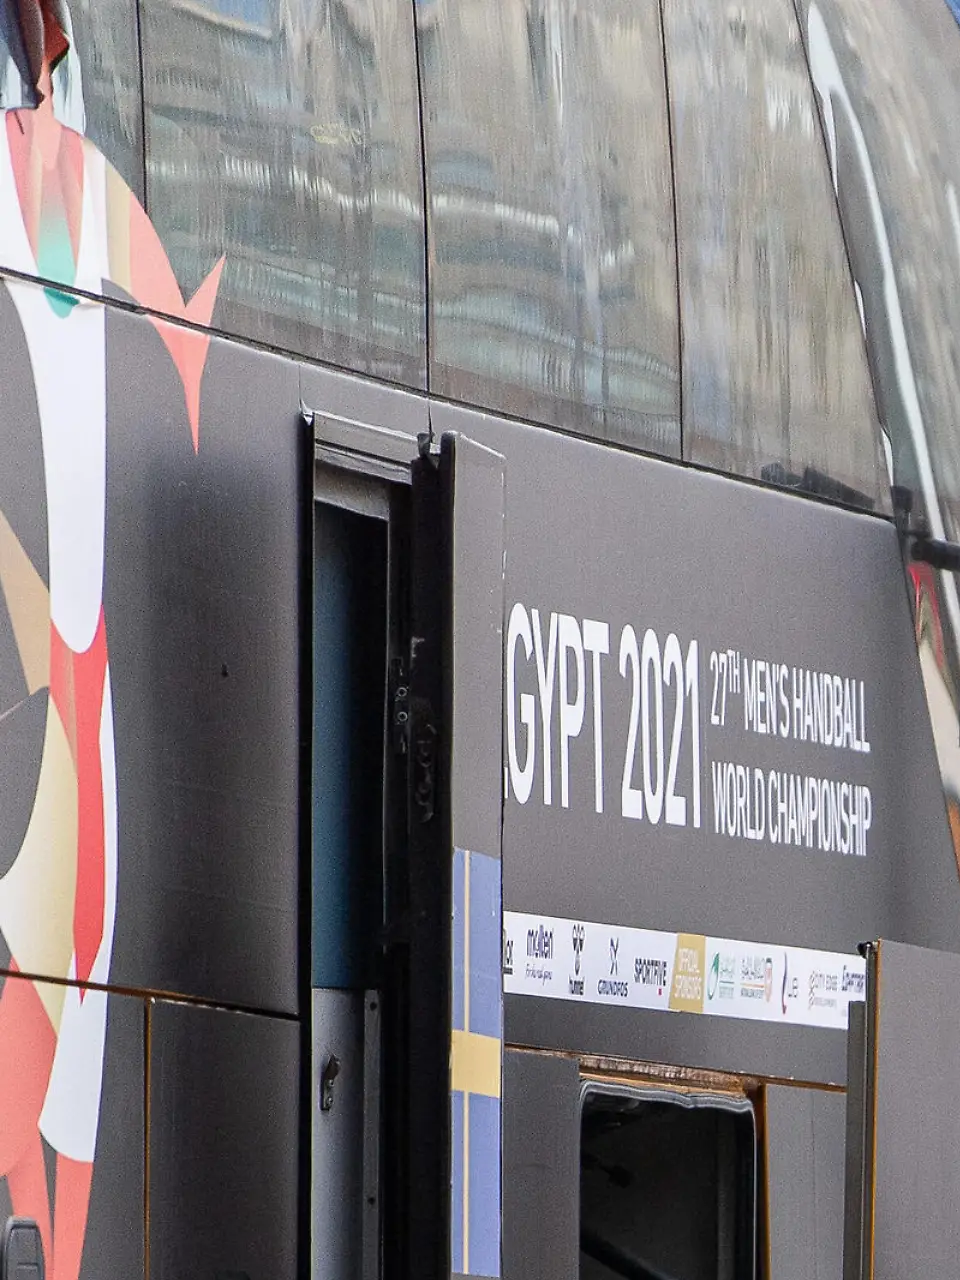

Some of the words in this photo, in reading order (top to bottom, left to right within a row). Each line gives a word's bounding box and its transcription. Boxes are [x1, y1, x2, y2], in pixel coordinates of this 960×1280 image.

[504, 602, 609, 813] GYPT
[619, 624, 700, 828] 2021
[743, 657, 790, 738] MEN'S
[792, 667, 871, 752] HANDBALL
[711, 761, 766, 840] WORLD
[767, 769, 873, 856] CHAMPIONSHIP
[597, 979, 629, 998] GRUNDFOS
[634, 957, 667, 987] SPORTFIVE
